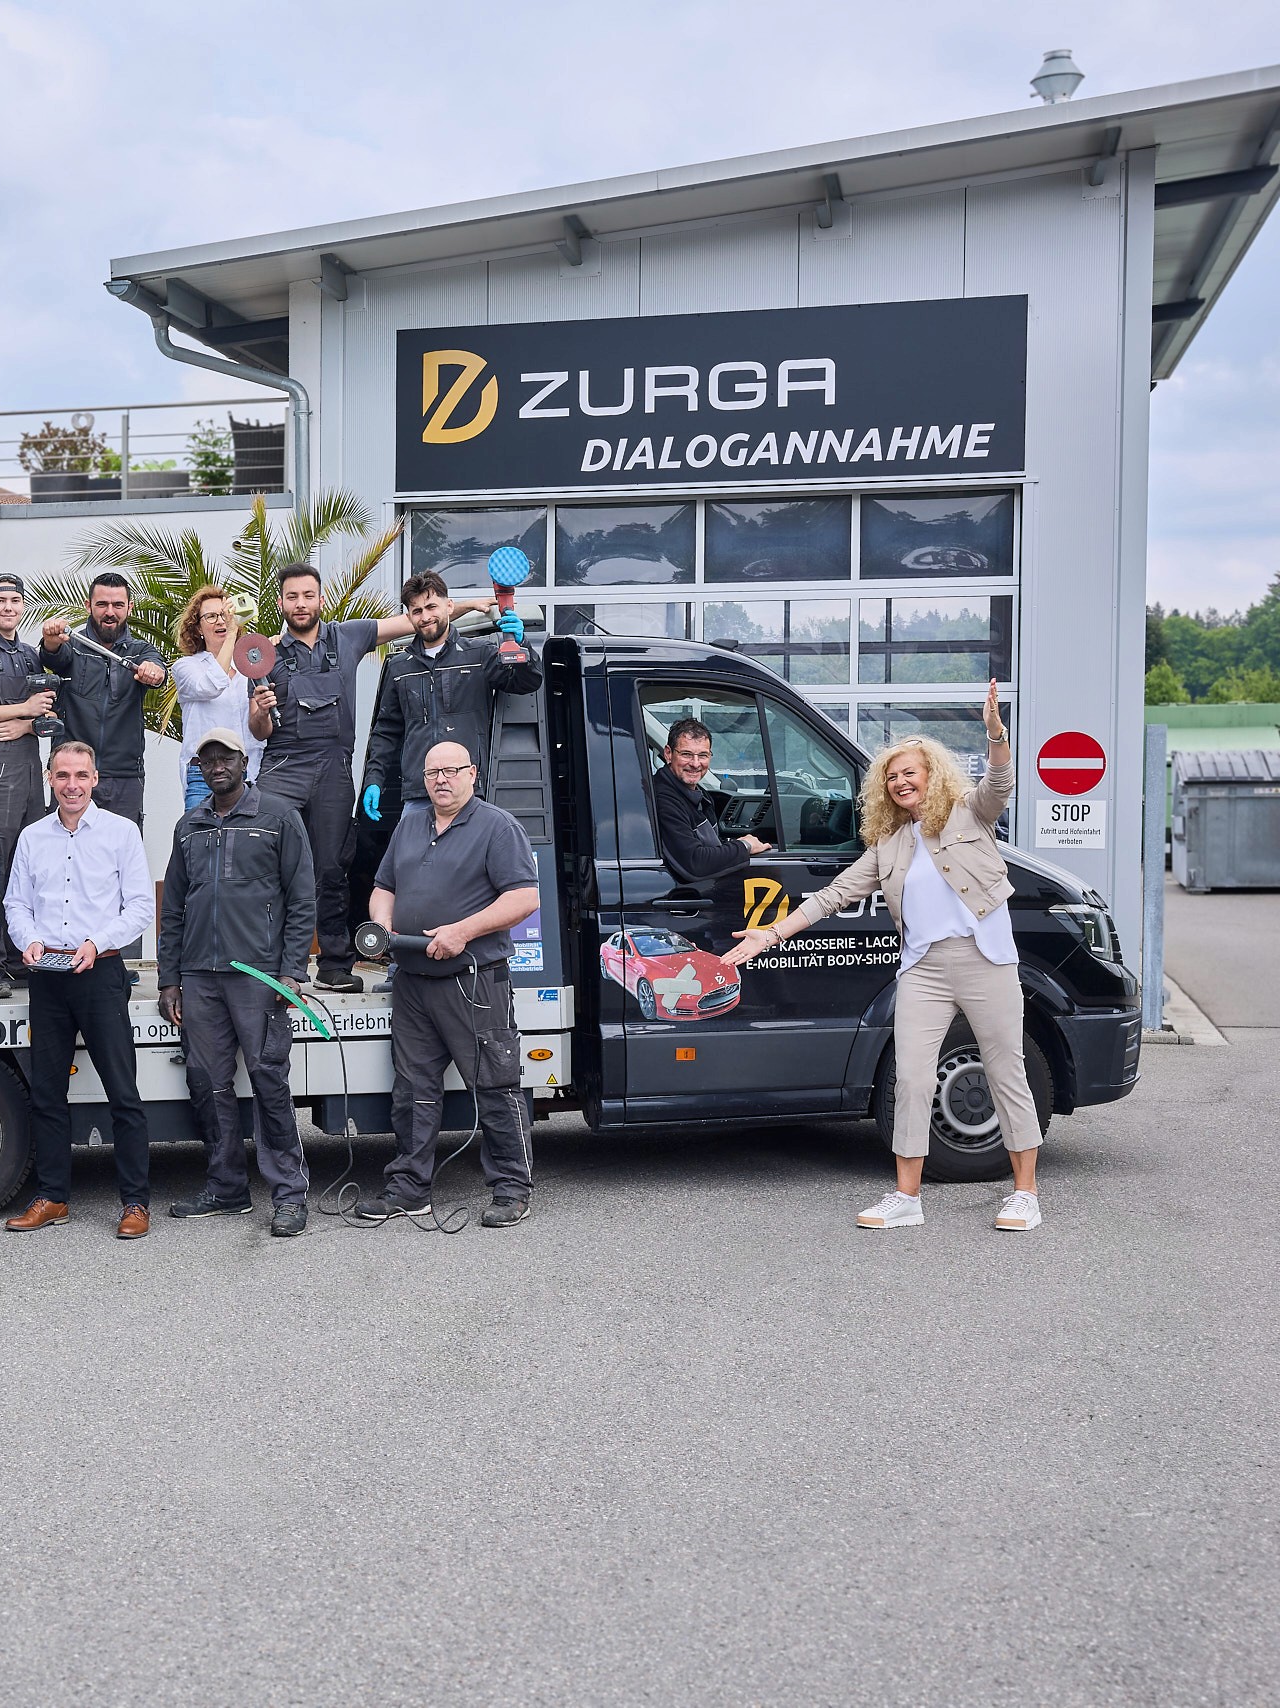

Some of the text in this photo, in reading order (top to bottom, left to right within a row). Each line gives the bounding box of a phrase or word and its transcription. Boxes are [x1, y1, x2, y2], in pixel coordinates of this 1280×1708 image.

[519, 357, 836, 419] ZURGA
[580, 423, 995, 472] DIALOGANNAHME
[1051, 804, 1091, 822] STOP
[1040, 827, 1101, 835] Zutritt und Hofeinfahrt
[779, 937, 856, 952] KAROSSERIE
[865, 936, 899, 948] LACK
[746, 952, 900, 970] E-MOBILITÄT BODY-SHOP
[148, 1022, 181, 1041] opt
